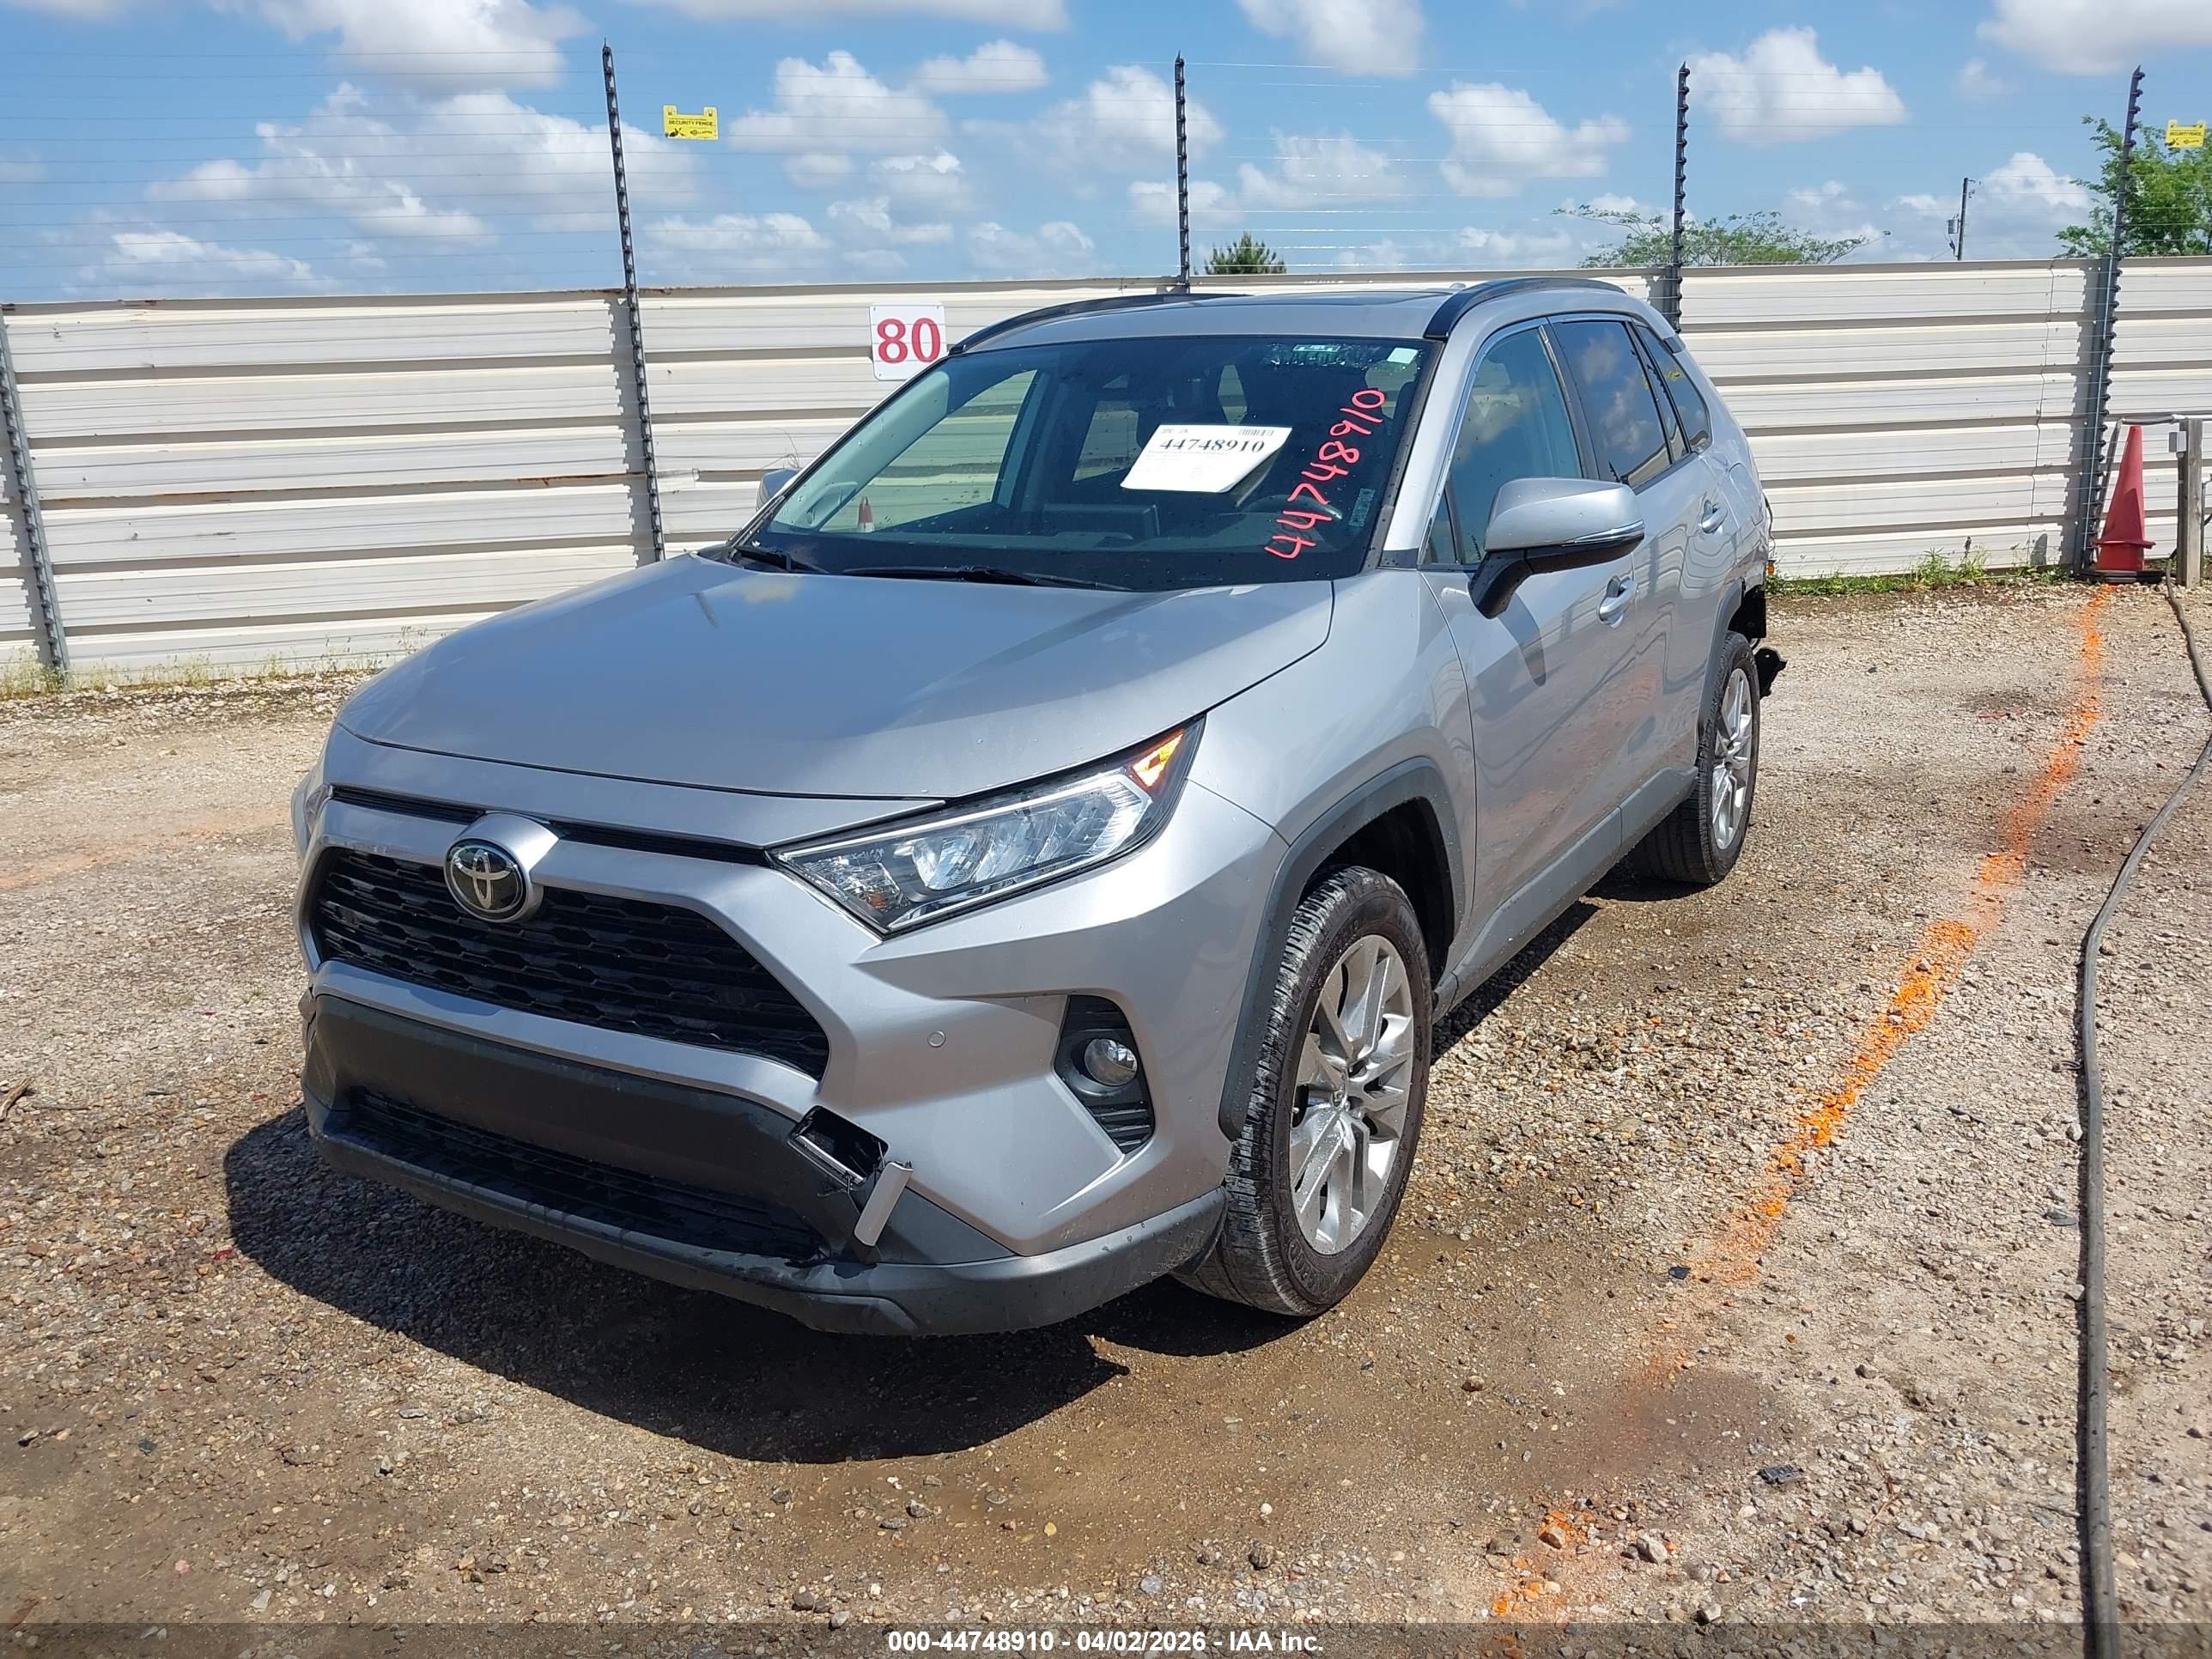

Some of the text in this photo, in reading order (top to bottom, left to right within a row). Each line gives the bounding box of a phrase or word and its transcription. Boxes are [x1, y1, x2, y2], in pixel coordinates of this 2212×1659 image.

[877, 318, 941, 364] 80
[1159, 438, 1265, 453] 44748910
[1264, 388, 1387, 560] 44748910
